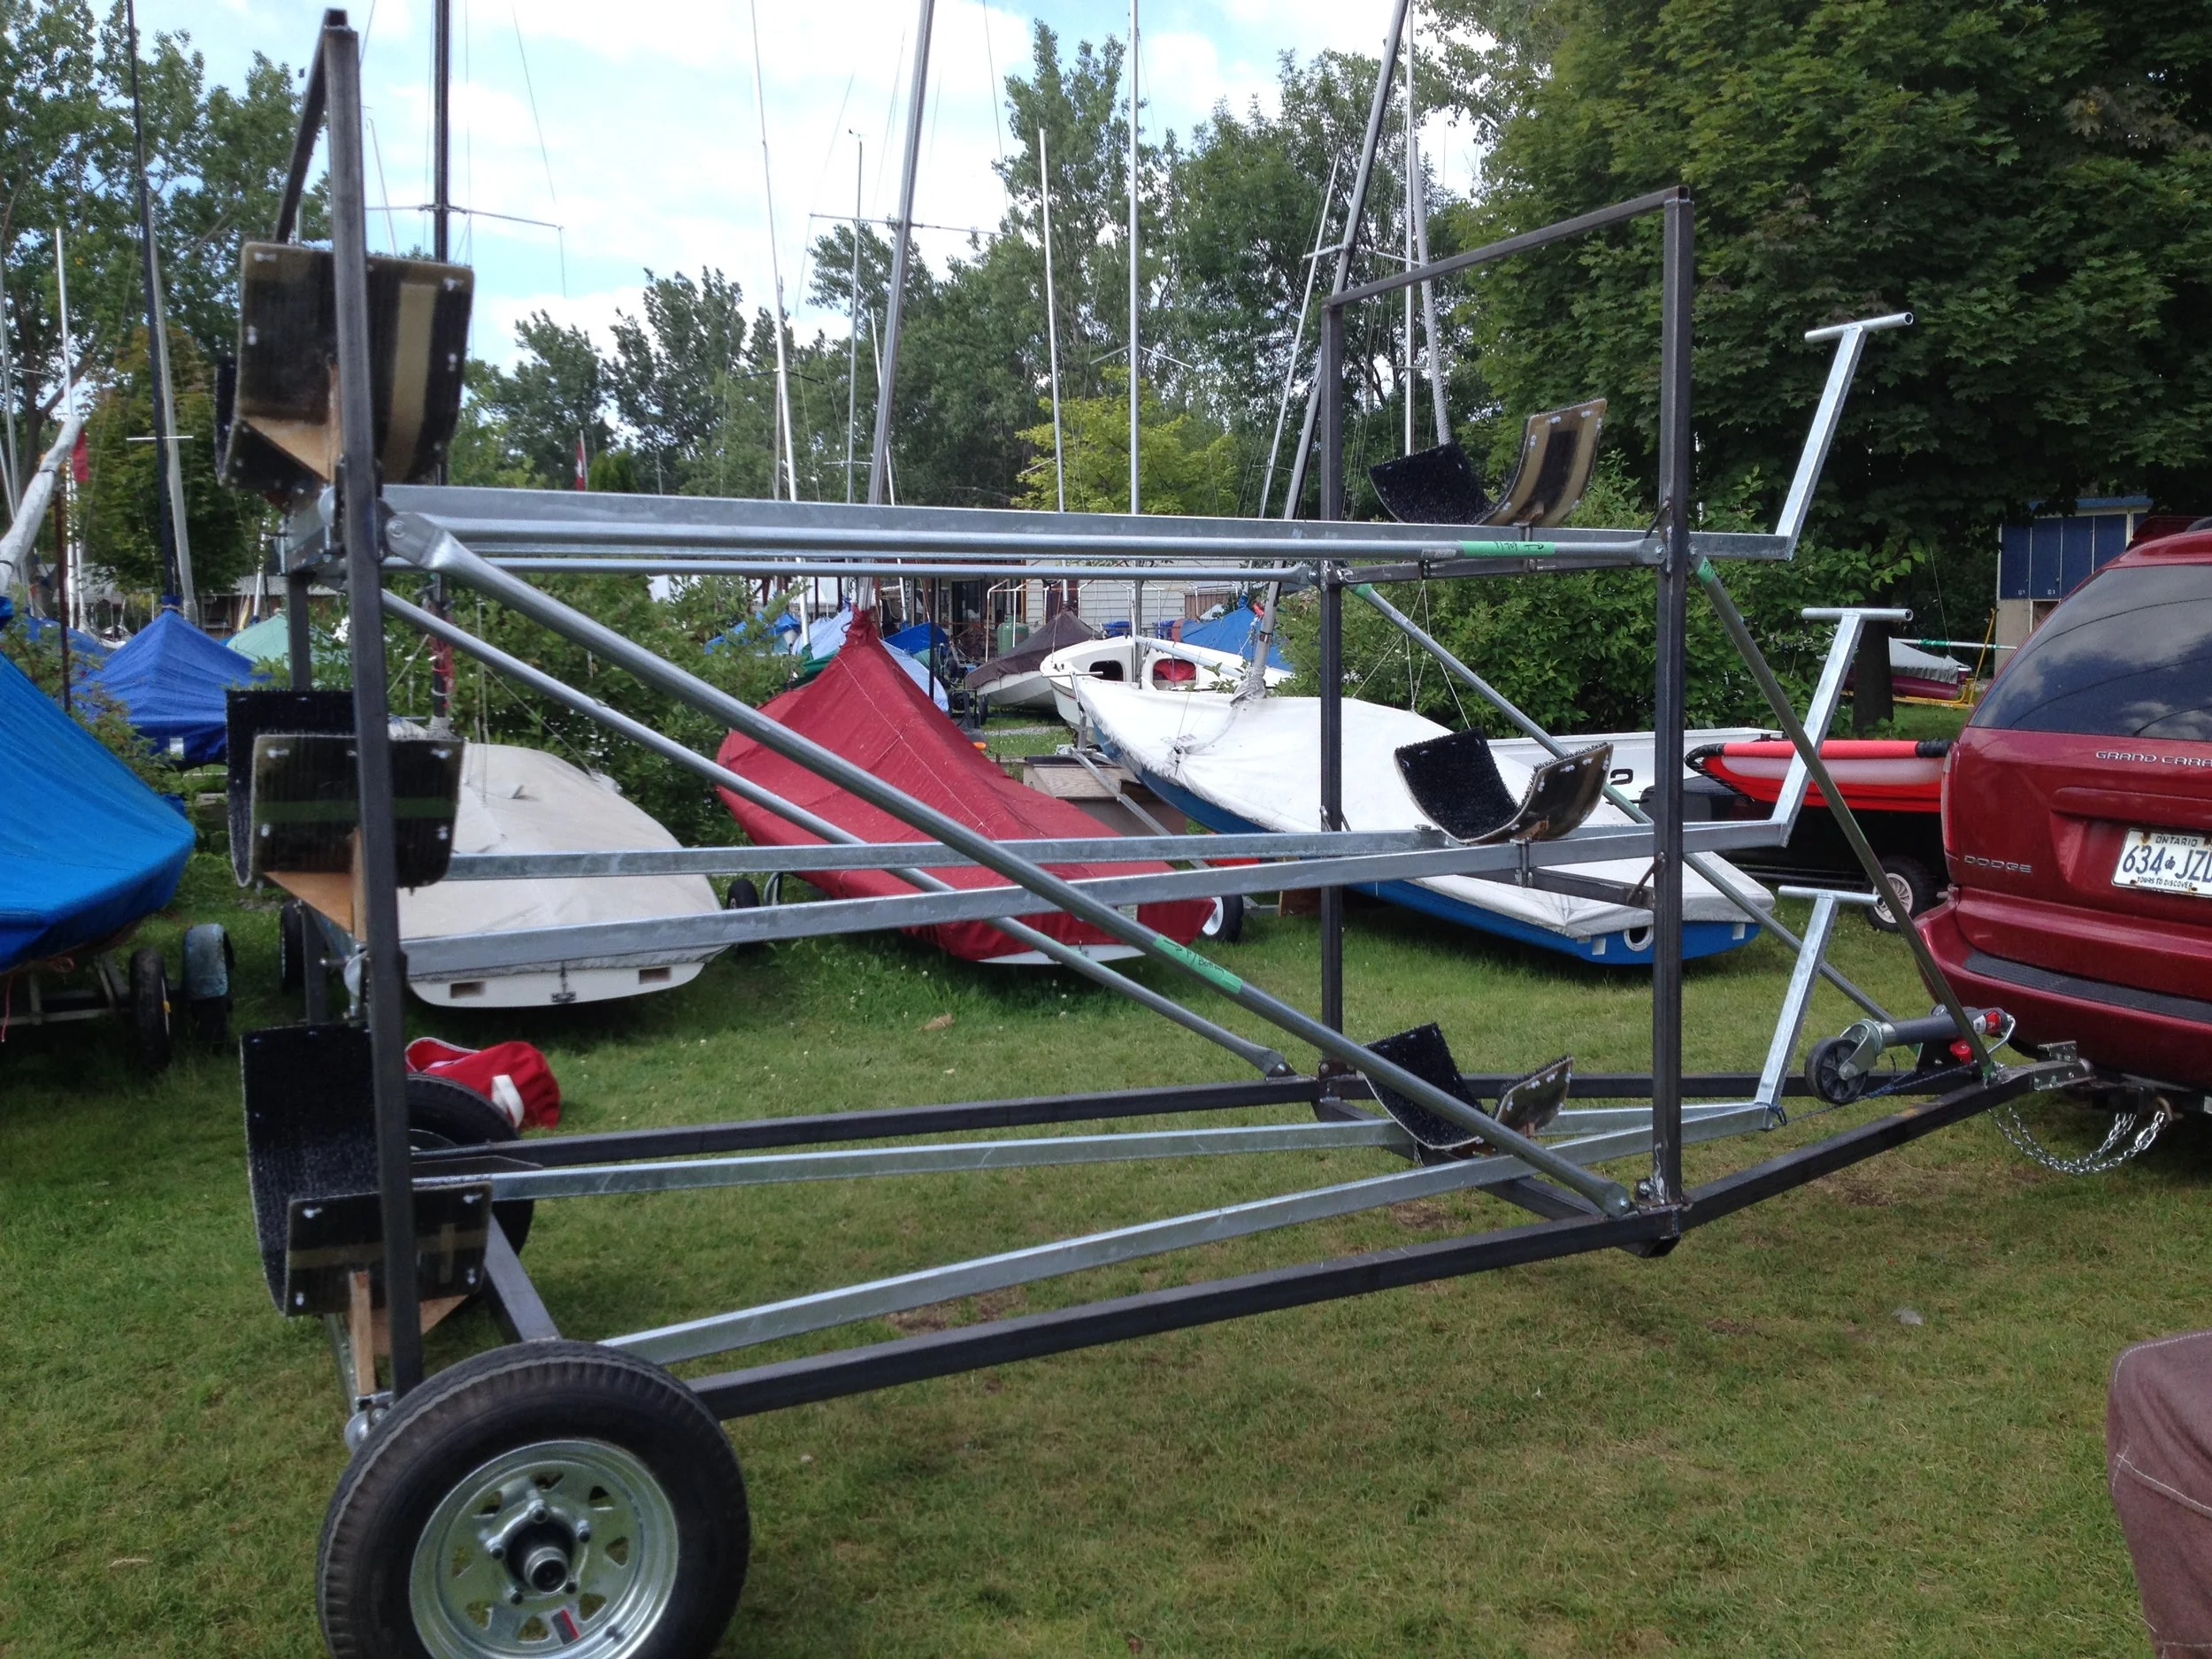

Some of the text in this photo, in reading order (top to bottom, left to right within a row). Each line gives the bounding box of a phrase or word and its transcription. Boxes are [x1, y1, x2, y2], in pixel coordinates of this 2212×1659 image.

[2095, 750, 2157, 763] GRAND
[2155, 836, 2199, 847] ONTARIO
[1964, 855, 2032, 873] DODGE
[2123, 845, 2166, 874] 634
[2163, 879, 2193, 888] DISCOVER
